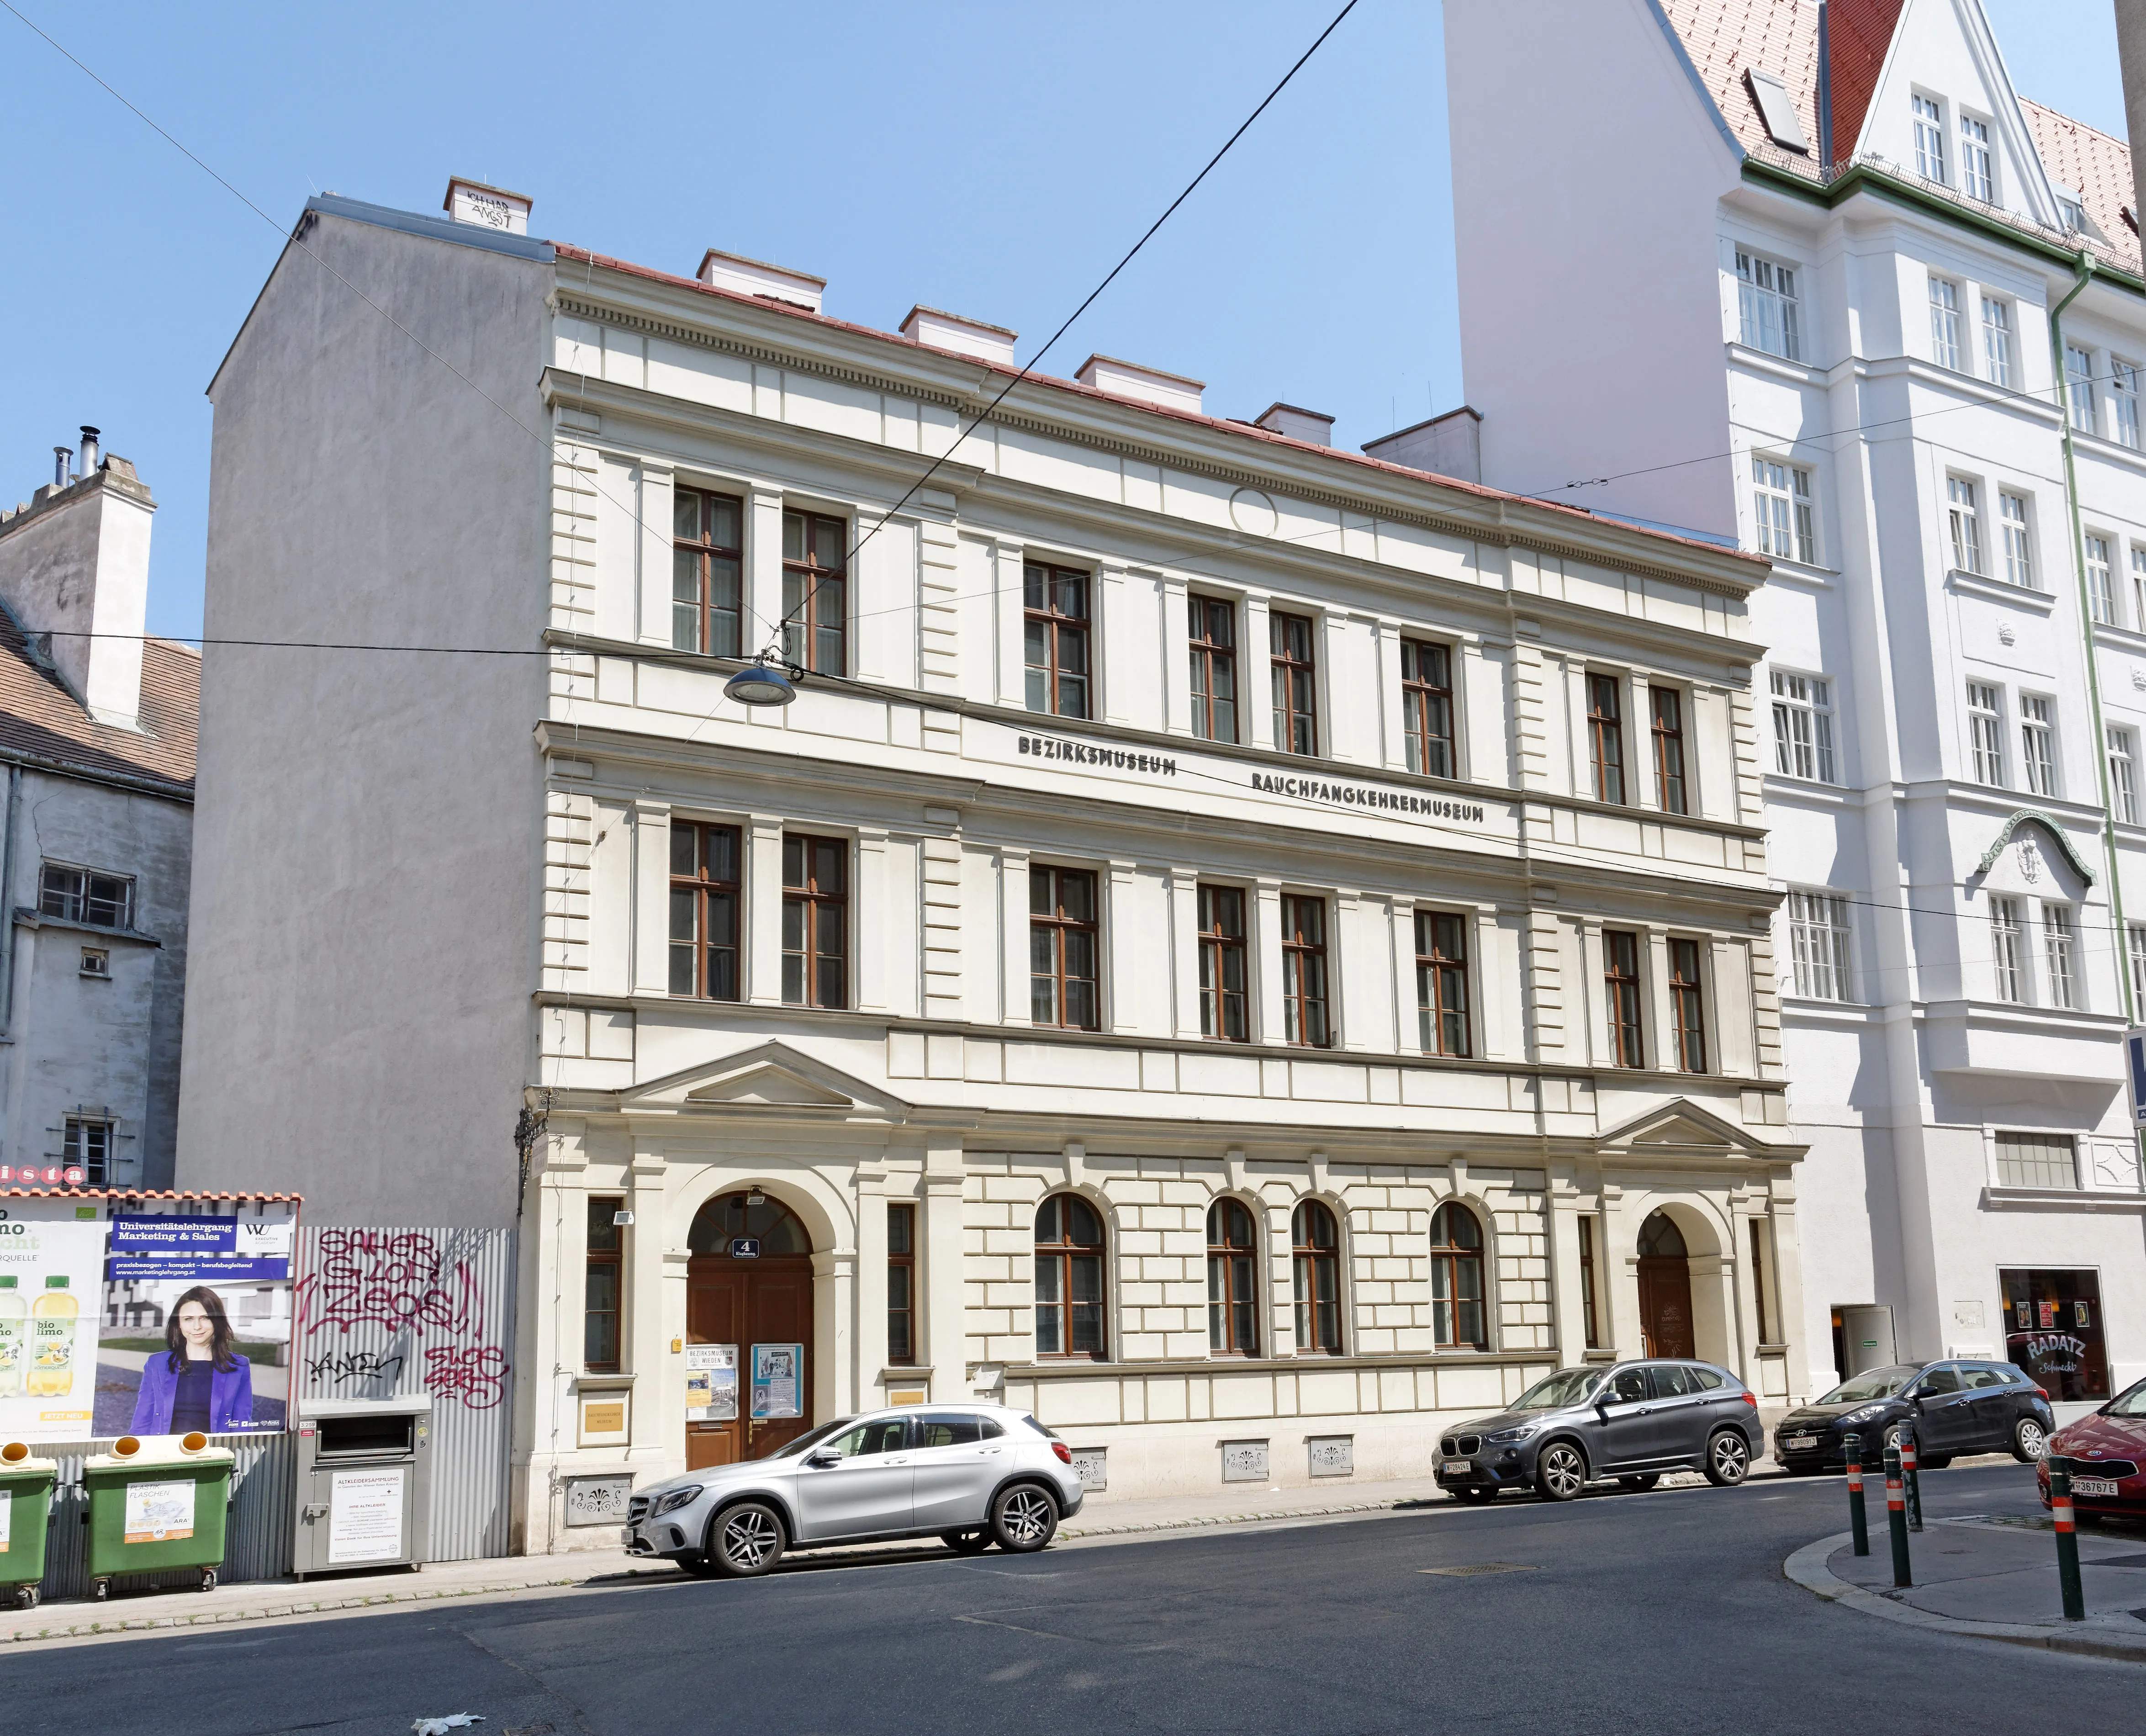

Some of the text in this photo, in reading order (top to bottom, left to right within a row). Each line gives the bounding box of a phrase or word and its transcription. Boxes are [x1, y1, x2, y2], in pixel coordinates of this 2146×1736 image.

[472, 205, 512, 228] ANGST
[1018, 736, 1175, 776] BEZIRKSMUSEUM
[1252, 773, 1483, 823] RAUCHFANGKEHRERMUSEUM
[119, 1222, 233, 1233] Universitätslehrgang
[118, 1232, 176, 1242] Marketing
[192, 1233, 220, 1241] Sales
[740, 1241, 750, 1251] 4
[2027, 1335, 2086, 1360] RADATZ
[2081, 1482, 2107, 1493] 36767
[2109, 1485, 2115, 1493] E
